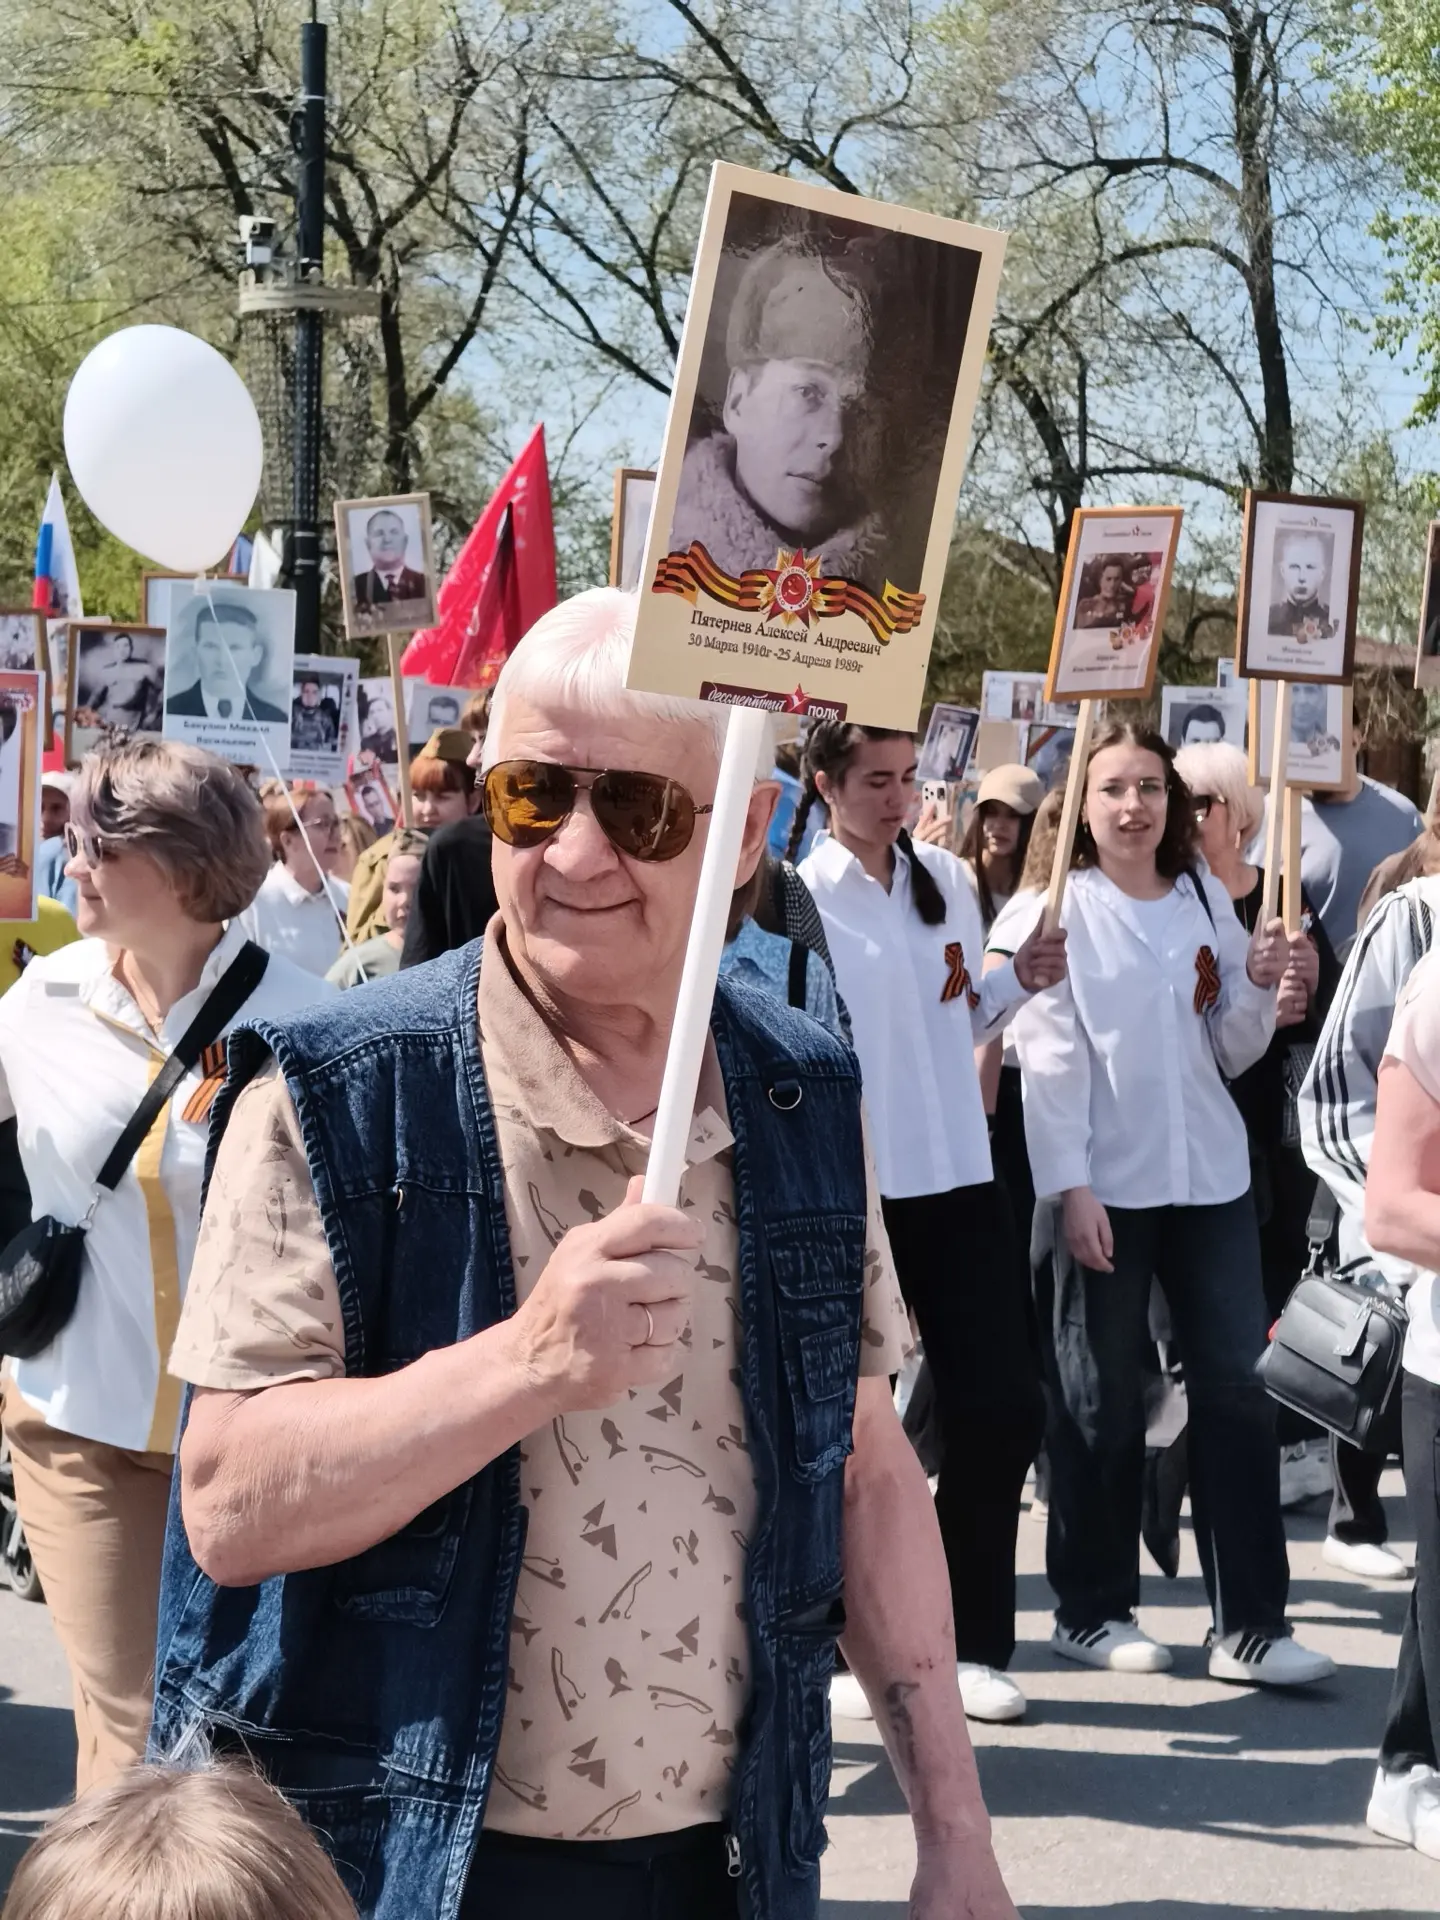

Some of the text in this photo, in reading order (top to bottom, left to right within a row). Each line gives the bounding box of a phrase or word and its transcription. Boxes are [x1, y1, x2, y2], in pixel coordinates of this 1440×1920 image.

[688, 633, 702, 647] 30
[704, 636, 739, 654] Марта
[792, 651, 831, 668] Апреля
[835, 656, 863, 673] 1989г
[690, 609, 881, 656] Пятернев Алексей Андреевич
